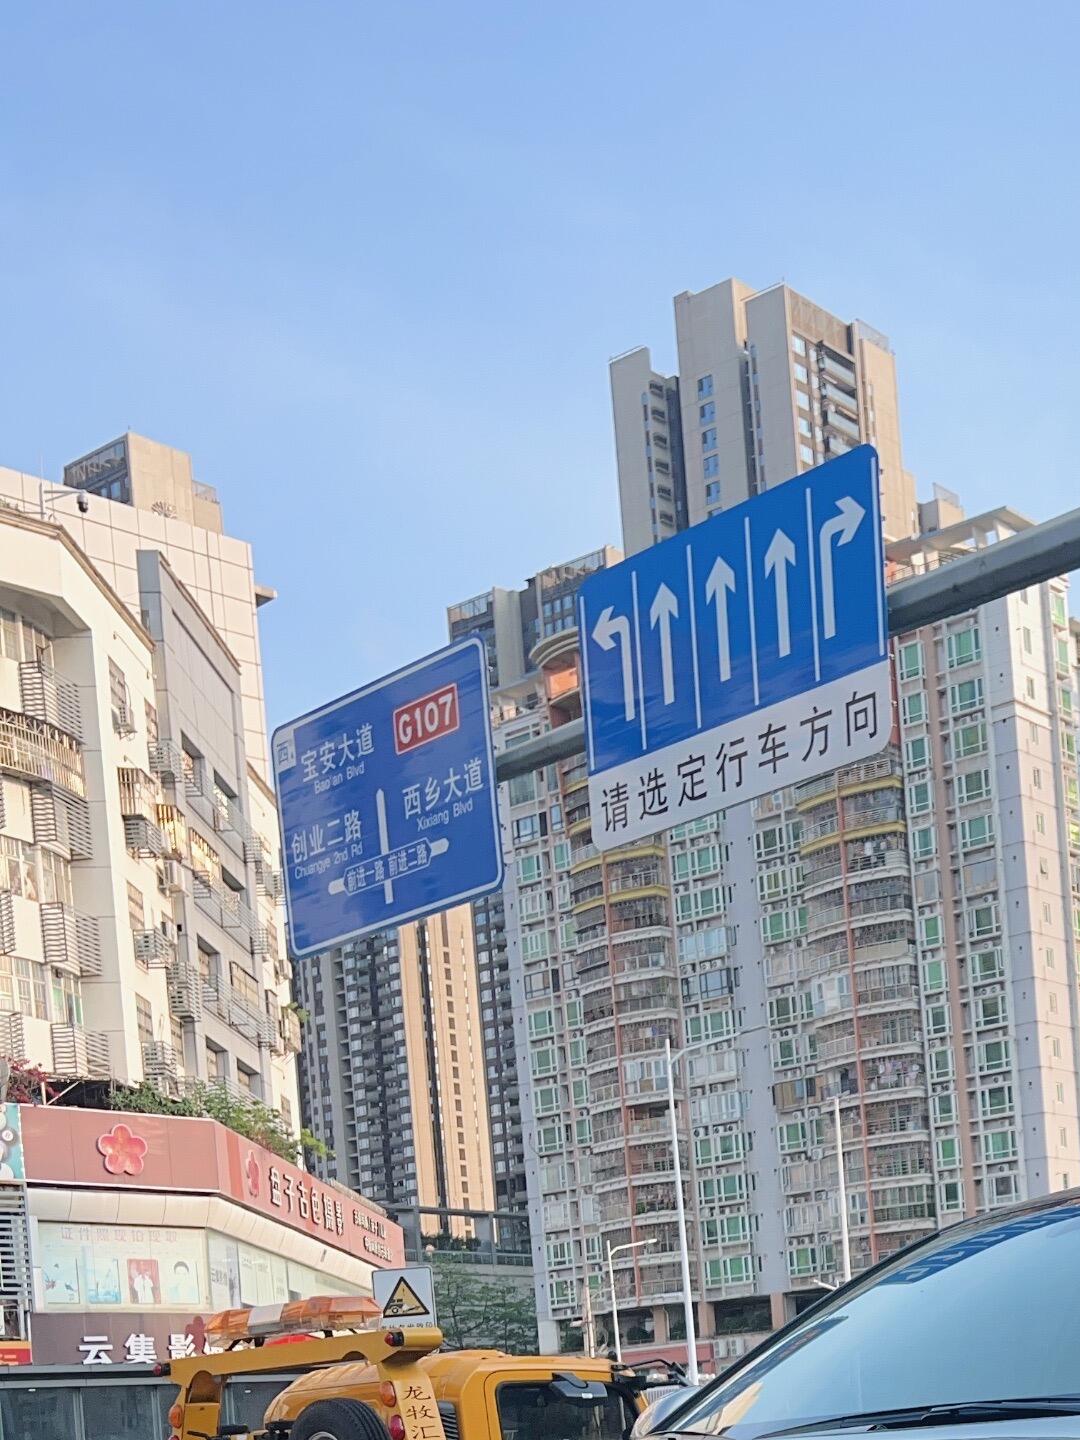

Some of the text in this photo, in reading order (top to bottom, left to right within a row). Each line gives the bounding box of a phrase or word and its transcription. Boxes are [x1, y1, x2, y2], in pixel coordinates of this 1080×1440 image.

[398, 693, 453, 744] G107
[300, 723, 375, 784] 宝安大道
[314, 760, 365, 795] Bao'an Blvd
[601, 690, 878, 833] 请选定行车方向
[402, 756, 484, 820] 西乡大道
[291, 809, 362, 864] 创业二路
[417, 798, 473, 832] Xixiang Blvd
[294, 840, 363, 880] Chuangye 2nd Rd
[347, 844, 428, 891] 前进一路 前进二路
